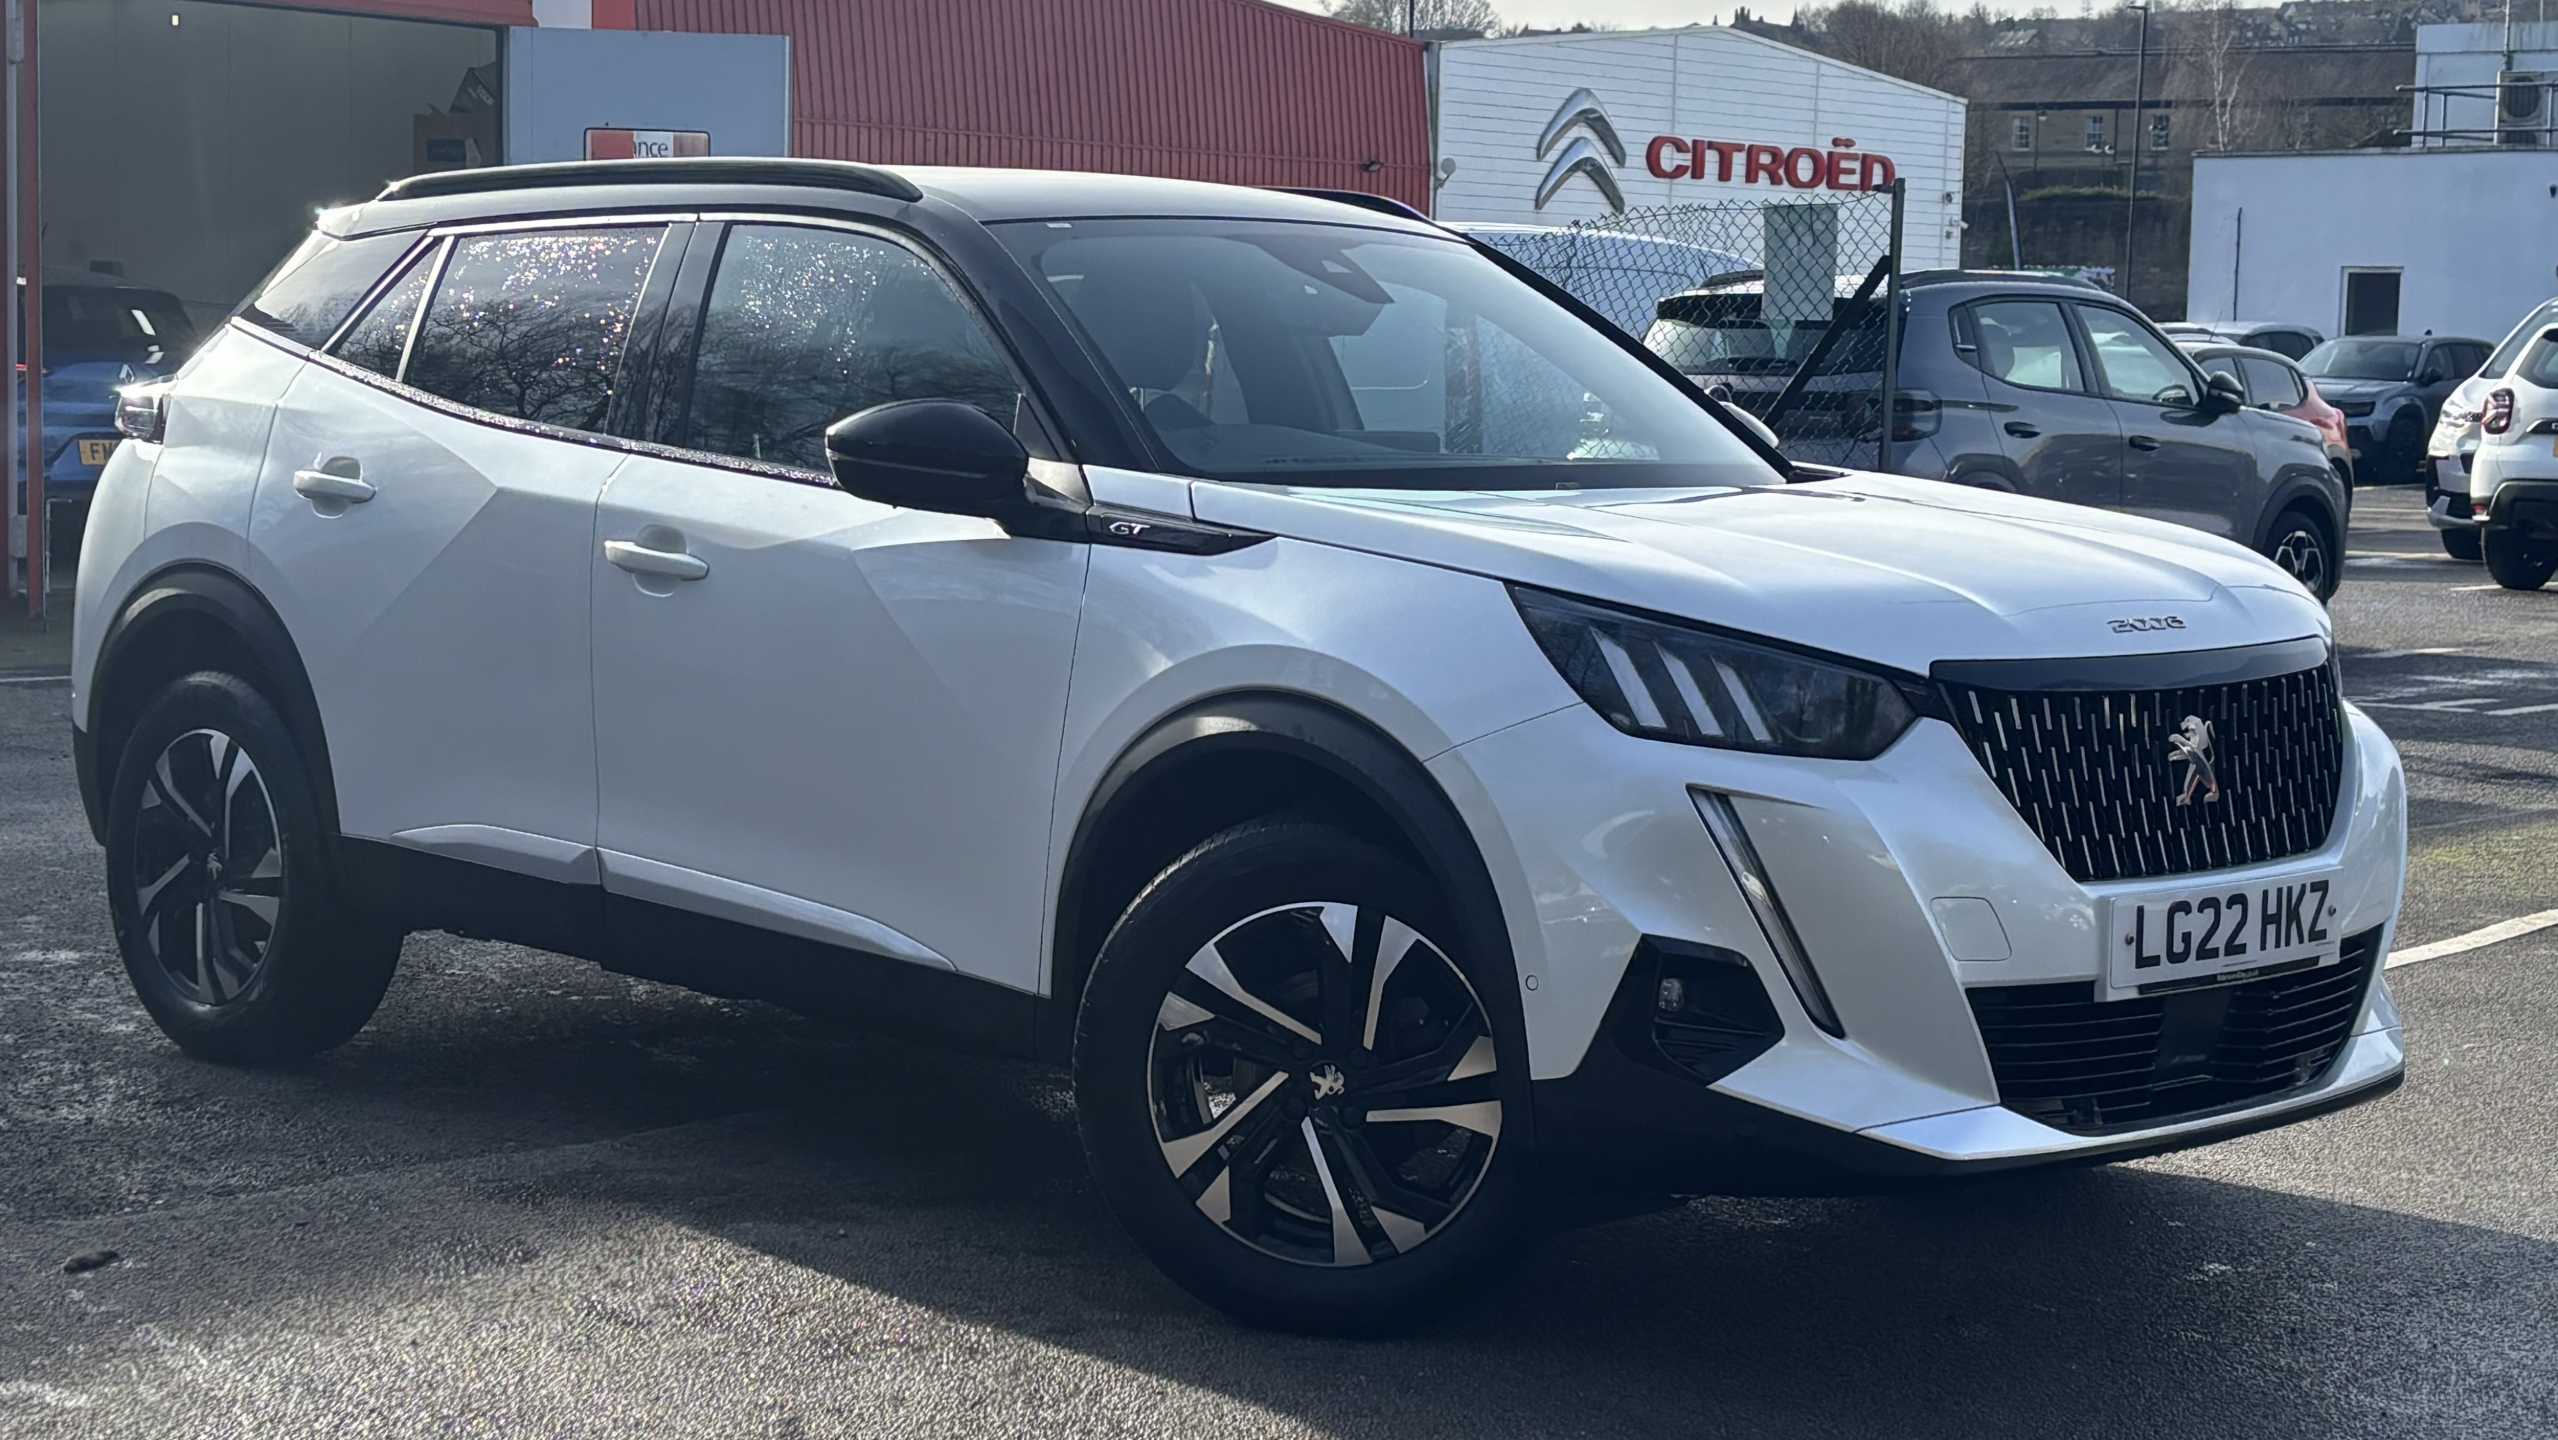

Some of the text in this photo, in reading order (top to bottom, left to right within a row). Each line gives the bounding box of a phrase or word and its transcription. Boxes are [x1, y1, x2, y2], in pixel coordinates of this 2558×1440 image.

[1645, 135, 1896, 192] CITROËN
[1109, 521, 1151, 535] GT
[2135, 879, 2330, 970] LG22 HKZ
